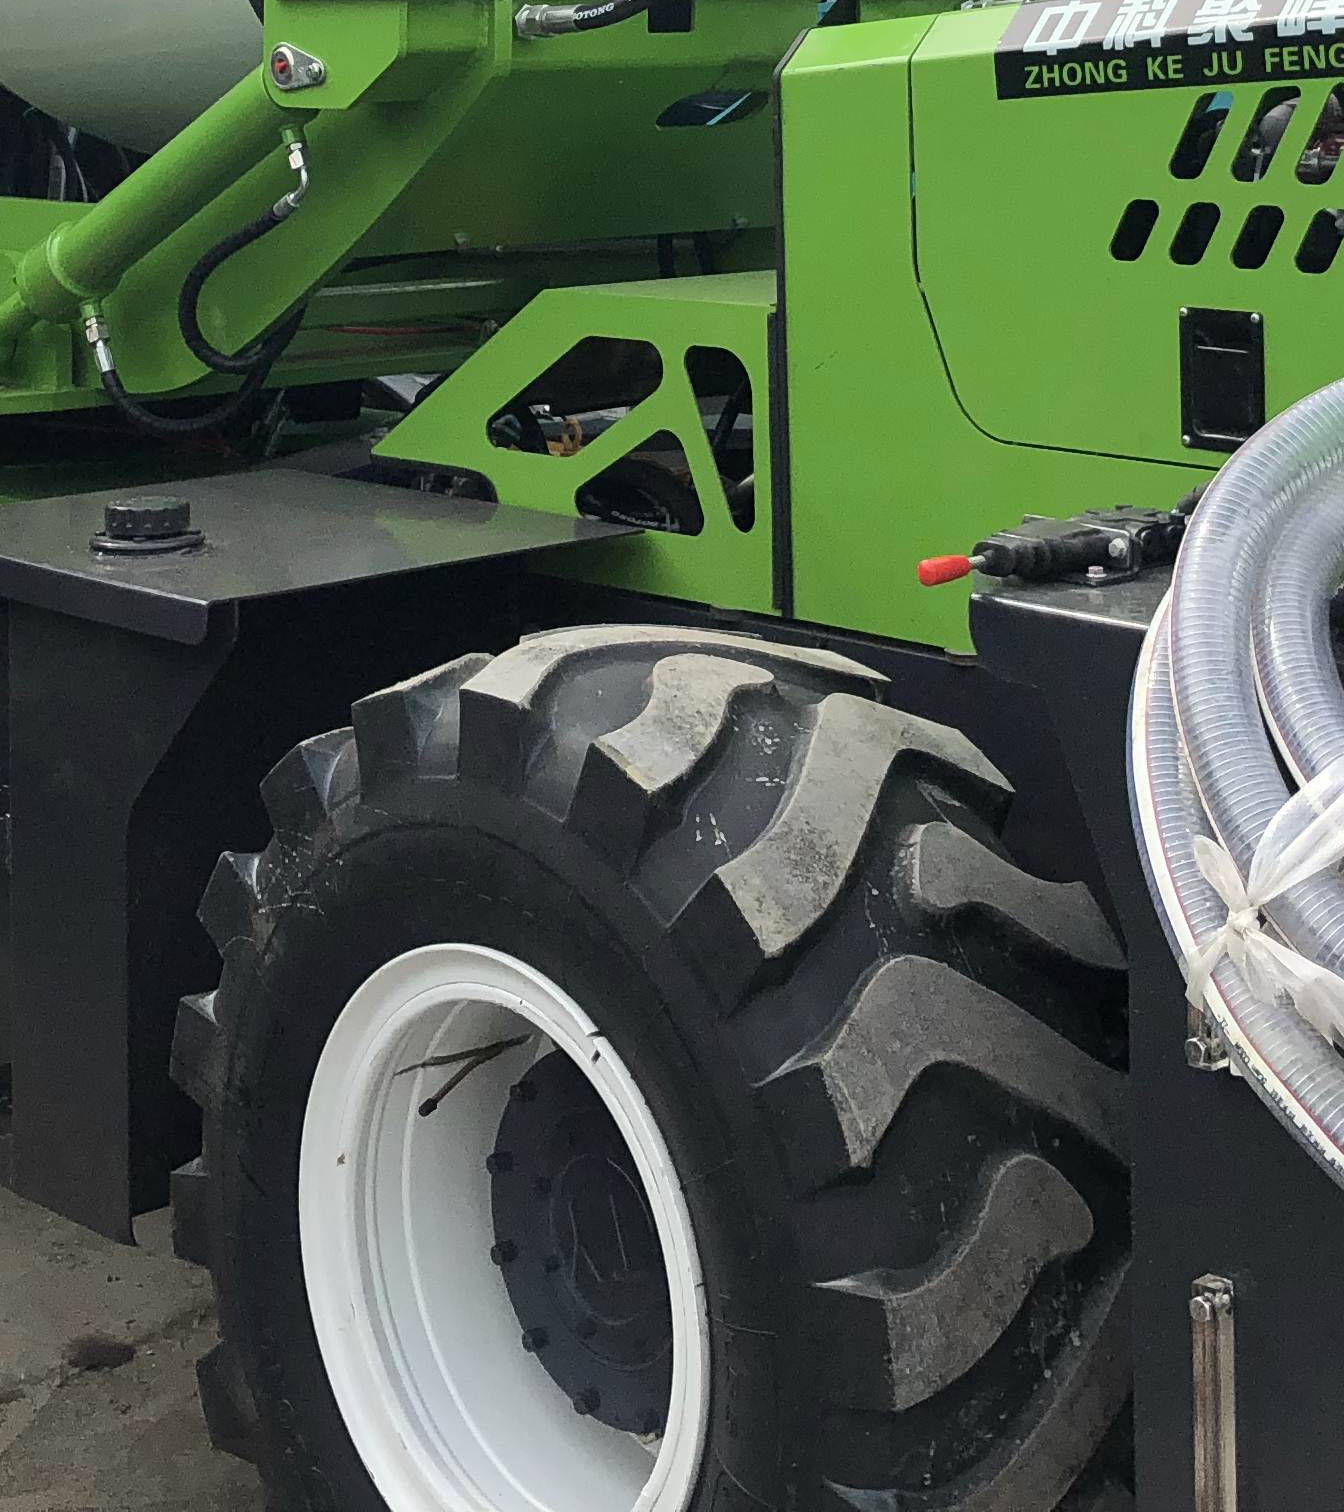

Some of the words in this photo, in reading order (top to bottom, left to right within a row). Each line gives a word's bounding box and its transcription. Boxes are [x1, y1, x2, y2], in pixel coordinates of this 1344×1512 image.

[572, 2, 615, 21] OTONG
[1024, 59, 1128, 89] ZHONG
[1147, 54, 1185, 81] KE
[1203, 50, 1243, 77] JU
